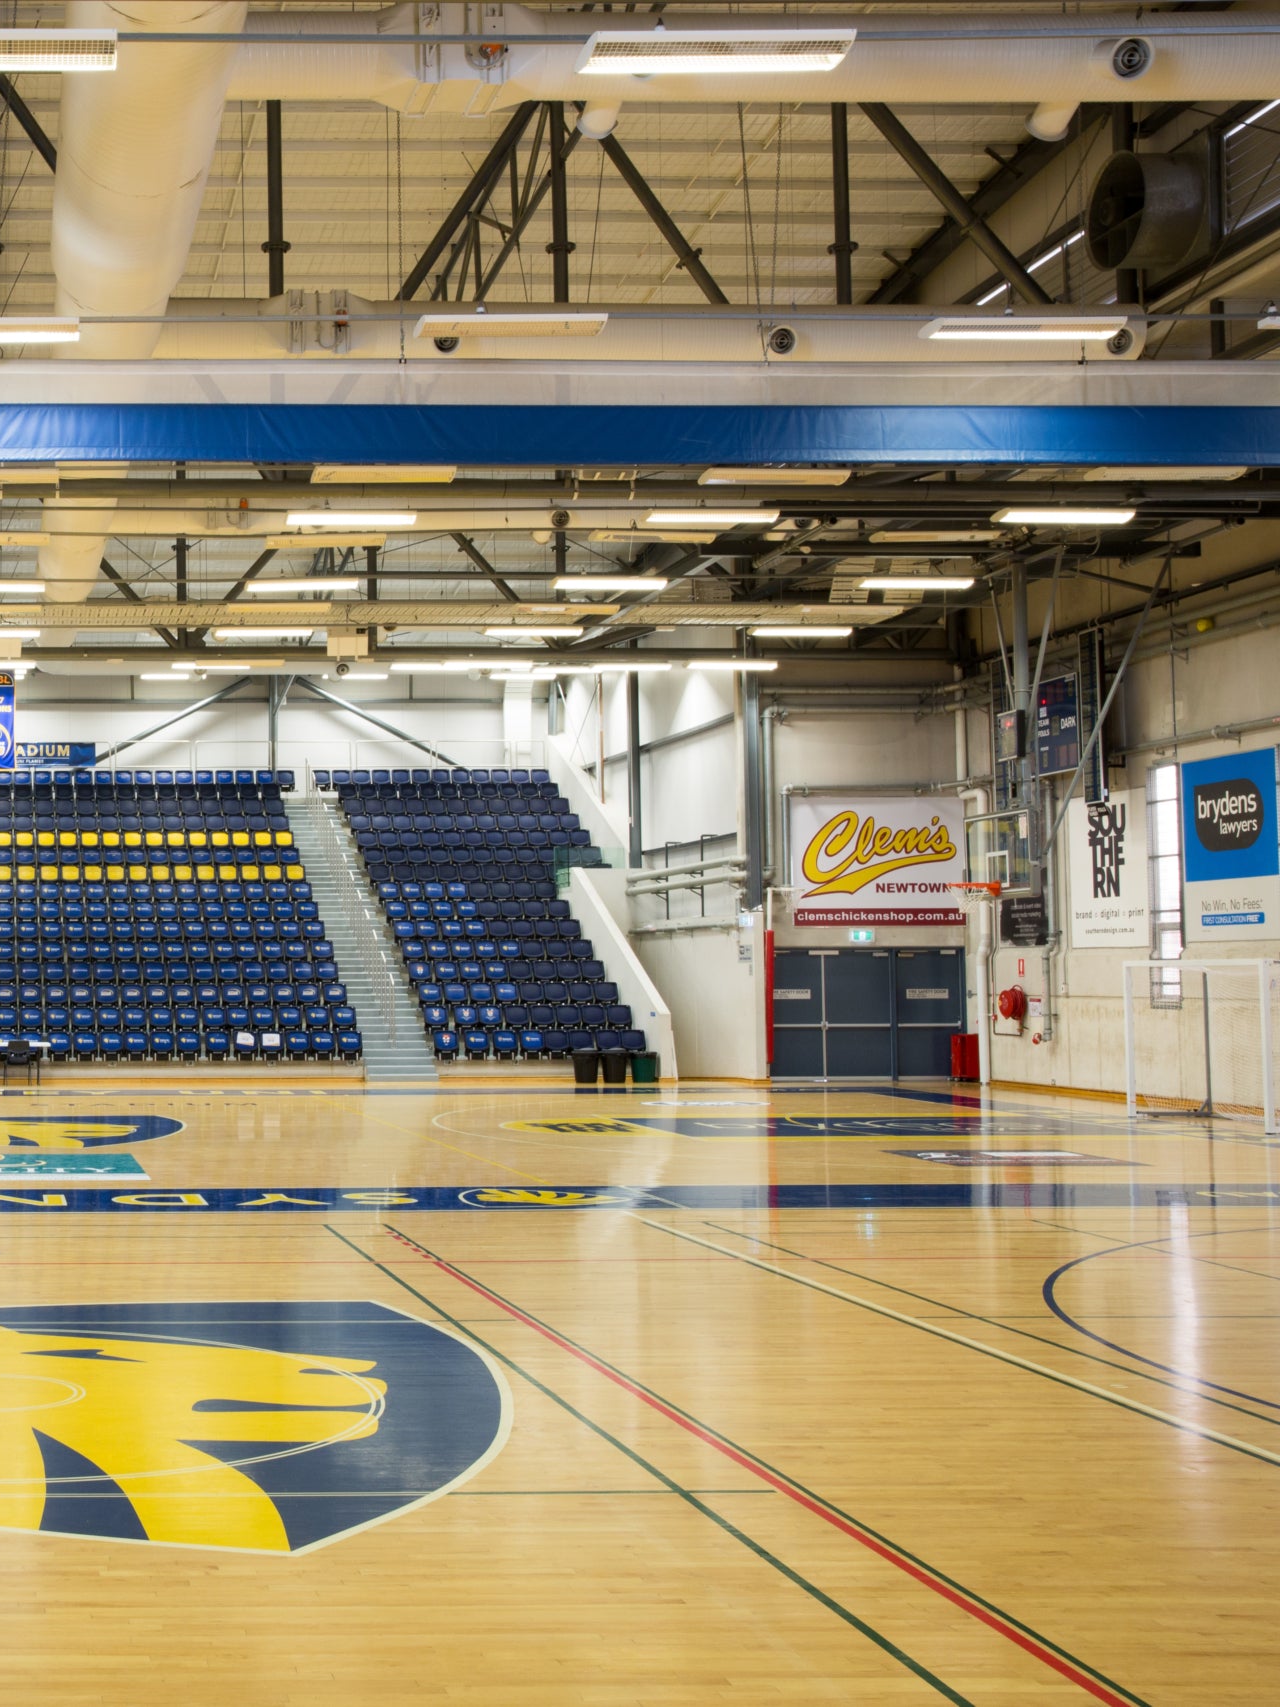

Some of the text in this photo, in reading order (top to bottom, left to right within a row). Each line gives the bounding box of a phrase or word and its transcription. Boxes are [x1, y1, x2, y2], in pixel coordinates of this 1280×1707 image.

[1060, 715, 1076, 730] DARK
[16, 745, 70, 757] ADIUM
[1197, 790, 1257, 824] brydens
[1087, 803, 1126, 838] SOU
[1220, 818, 1258, 838] lawyers
[802, 810, 957, 885] Clem's
[1088, 834, 1125, 868] THE
[1093, 866, 1121, 899] RN
[1201, 900, 1212, 912] No
[1212, 899, 1228, 912] Win,
[1230, 899, 1241, 911] No
[797, 911, 963, 923] clemschickenshop.com.au
[1075, 908, 1144, 921] brand digital print
[1085, 927, 1134, 935] southerndesign.com.au
